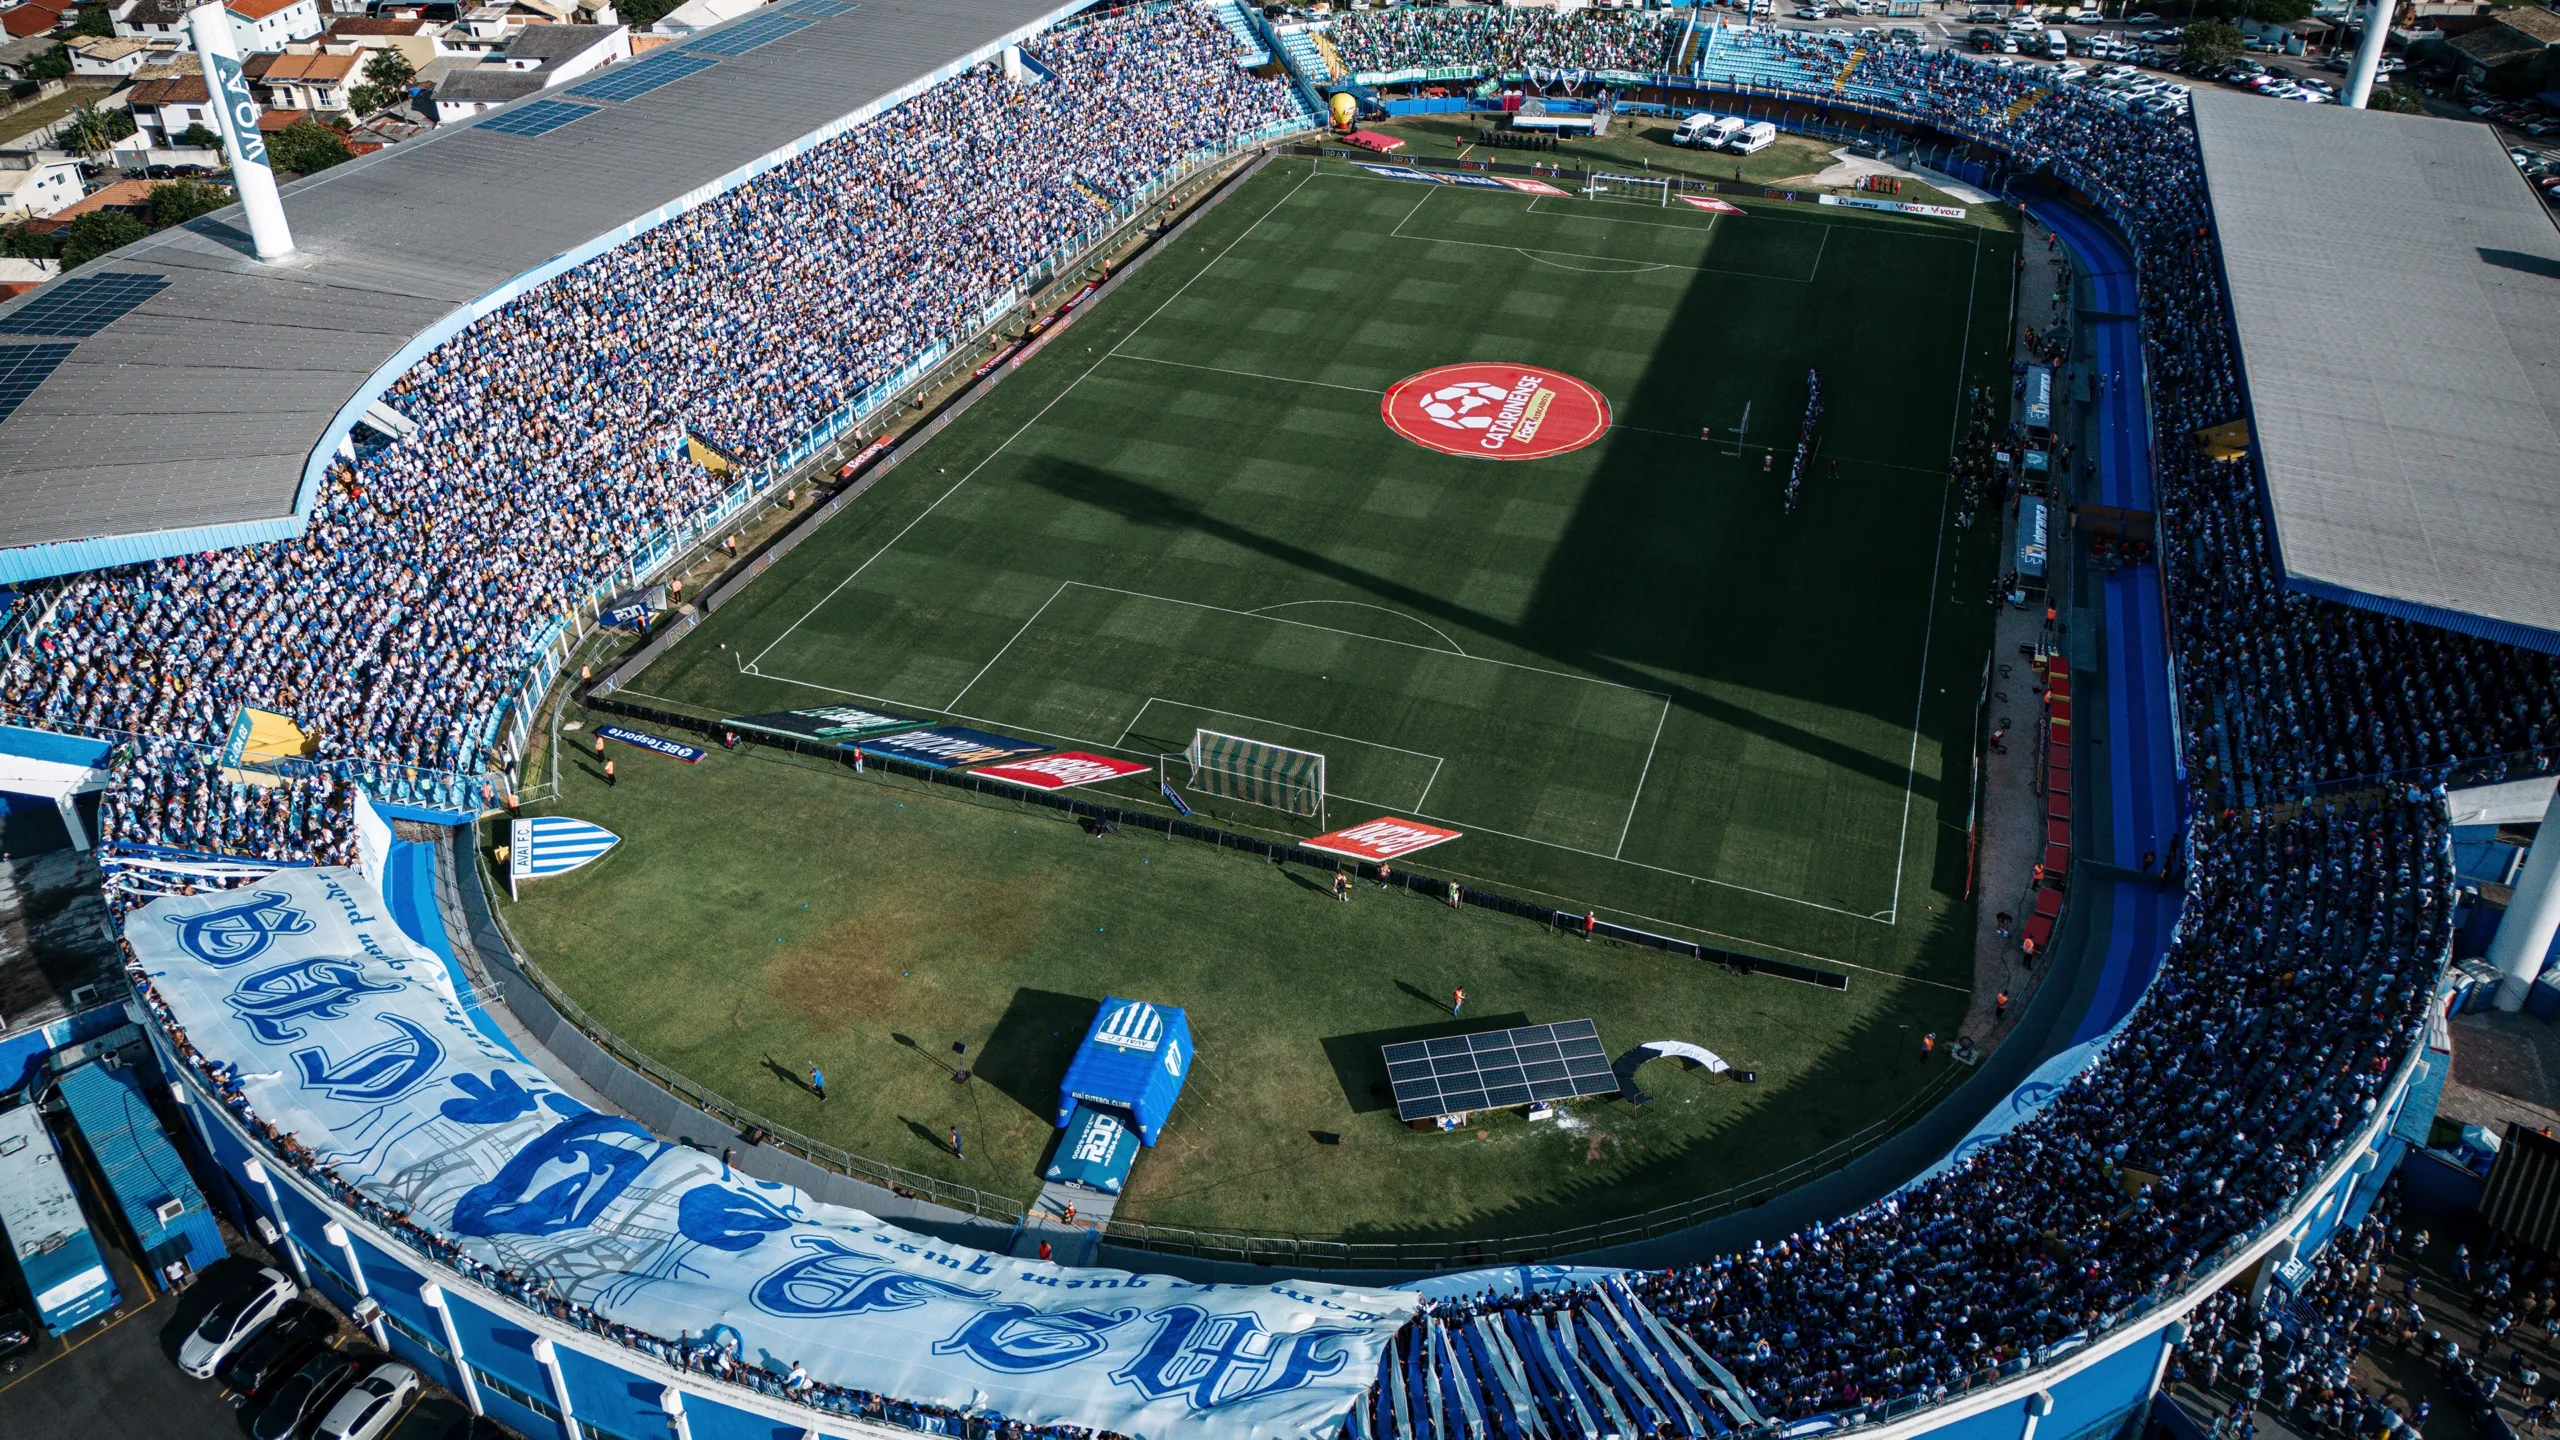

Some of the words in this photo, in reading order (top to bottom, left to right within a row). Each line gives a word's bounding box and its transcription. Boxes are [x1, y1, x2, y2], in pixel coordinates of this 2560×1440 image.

[1428, 67, 1473, 79] BARRA
[681, 180, 724, 210] MAIOR
[769, 143, 799, 165] MAIS
[815, 102, 882, 142] APAIXONADA
[971, 42, 1001, 63] SANTA
[1325, 149, 1348, 159] BRAX
[1393, 156, 1417, 165] BRAX
[1904, 205, 1926, 213] VOLT
[1940, 208, 1961, 217] VOLT
[1480, 375, 1544, 449] CATARINENSE
[1532, 392, 1553, 422] ATACADISTA
[815, 431, 829, 447] TIME
[846, 443, 883, 468] Betano
[818, 499, 840, 523] BRAX
[655, 544, 669, 559] PRA
[669, 617, 696, 643] BRAX
[238, 723, 248, 740] 03
[608, 728, 681, 754] BETesporte
[994, 757, 1118, 784] SUPERBET
[1337, 822, 1444, 854] Betano
[316, 872, 376, 927] puder
[1085, 1094, 1110, 1105] FUTEBOL
[1111, 1100, 1132, 1109] CLUBE
[1079, 1114, 1118, 1163] RDO
[2280, 1256, 2304, 1280] RDO
